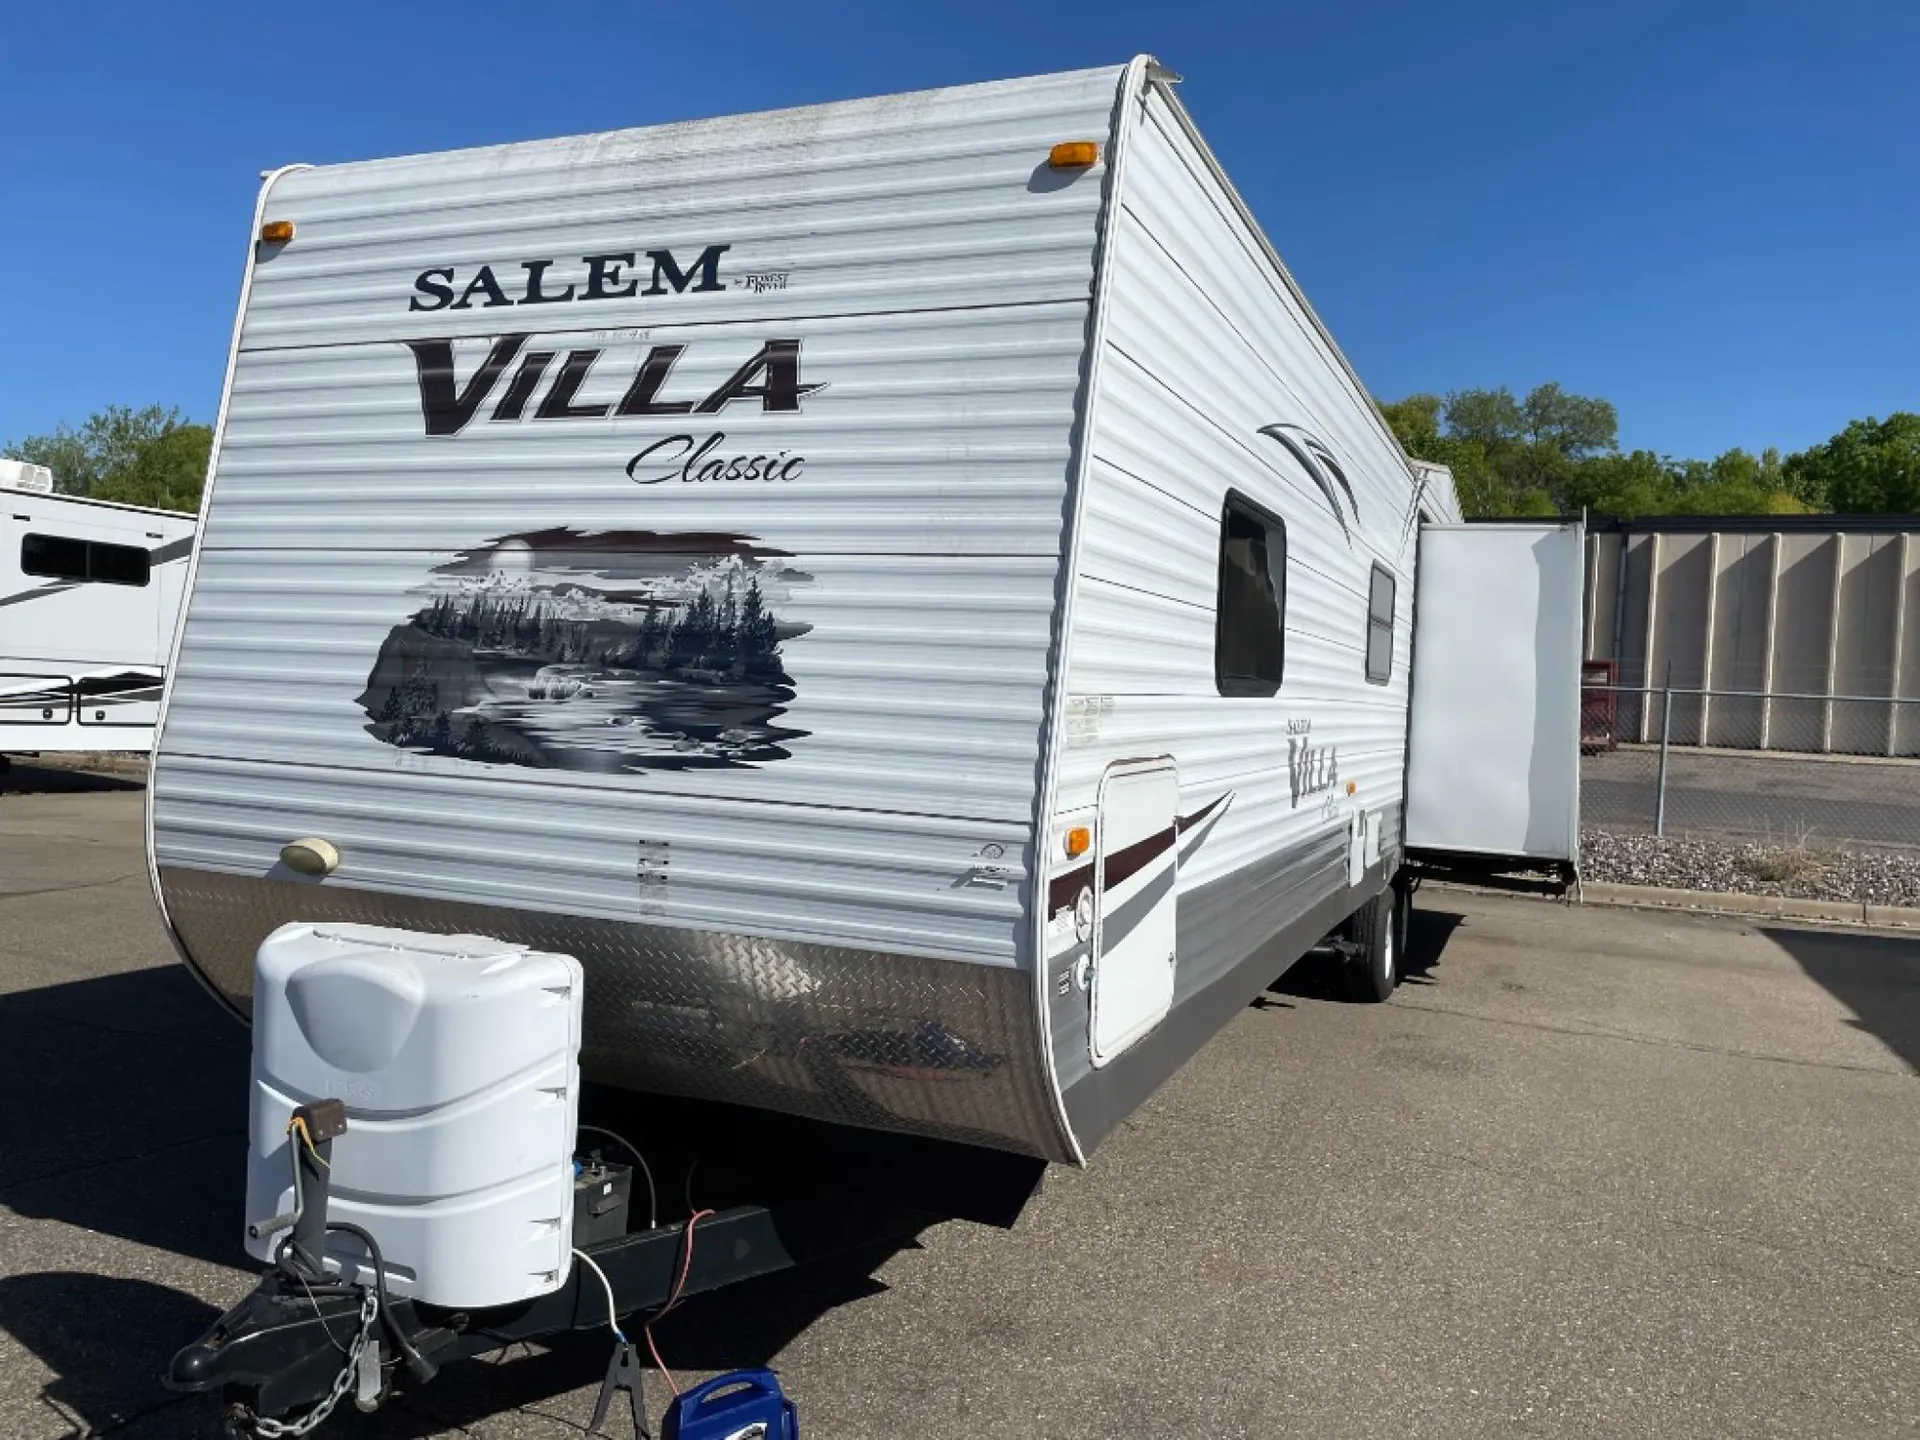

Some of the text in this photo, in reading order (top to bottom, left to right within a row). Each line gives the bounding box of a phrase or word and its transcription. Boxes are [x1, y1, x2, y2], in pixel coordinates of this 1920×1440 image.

[409, 244, 731, 312] SALEM
[400, 332, 830, 438] VILLA
[625, 431, 805, 484] Classic
[1287, 736, 1338, 809] VILLA
